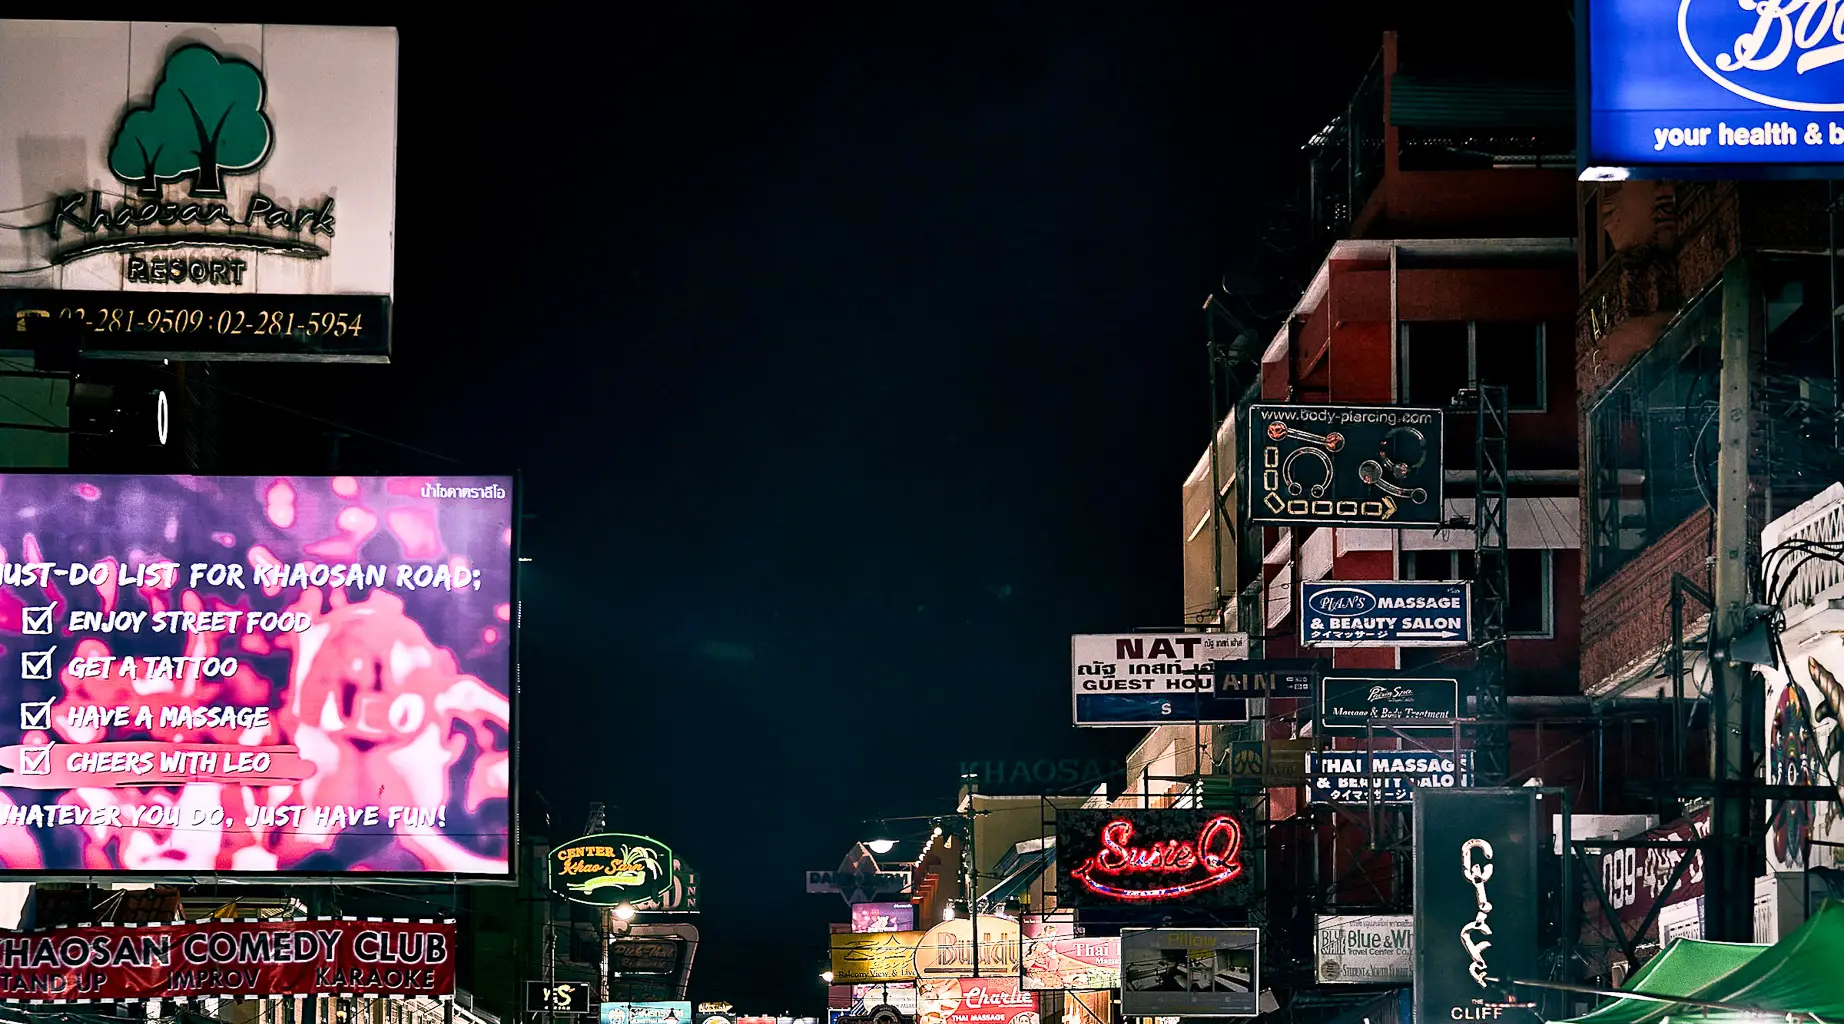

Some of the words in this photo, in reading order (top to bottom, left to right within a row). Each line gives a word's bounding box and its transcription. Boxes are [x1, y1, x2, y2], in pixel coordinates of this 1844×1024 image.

[1654, 125, 1711, 151] your
[1719, 121, 1797, 146] health
[1803, 122, 1823, 146] &
[51, 193, 232, 241] Khaosan
[244, 194, 337, 238] Park
[127, 258, 246, 285] RESORT
[1261, 409, 1432, 426] www.body-piercing.com
[0, 563, 110, 588] UST-DO
[118, 563, 180, 588] LIST
[190, 563, 245, 590] FOR
[253, 563, 387, 590] KHAOSAN
[1377, 597, 1461, 609] MASSAGE
[69, 611, 148, 633] ENJOY
[152, 611, 244, 634] STREET
[247, 612, 312, 634] FOOD
[1310, 618, 1325, 630] &
[1330, 618, 1397, 630] BEAUTY
[1402, 618, 1461, 630] SALON
[1311, 631, 1389, 639] タイマッサージ
[1116, 637, 1202, 660] NAT
[68, 656, 116, 680] GET
[119, 656, 138, 680] A
[144, 656, 238, 680] TATTOO
[1083, 679, 1155, 691] GUEST
[68, 705, 131, 730] HAVE
[135, 705, 153, 730] A
[160, 706, 270, 730] MASSAGE
[1381, 707, 1402, 719] Body
[1405, 708, 1449, 719] Treatment
[66, 752, 154, 775] CHEERS
[160, 752, 219, 775] WITH
[222, 752, 271, 774] LEO
[1317, 778, 1331, 789] &
[131, 805, 182, 828] YOU
[245, 805, 306, 828] JUST
[314, 805, 380, 829] HAVE
[387, 805, 447, 828] FUN!
[557, 846, 617, 861] CENTER
[1098, 820, 1196, 871] Susie
[1198, 815, 1241, 872] Q
[558, 858, 604, 875] Khao
[604, 858, 645, 875] Sarn
[183, 929, 343, 965] COMEDY
[353, 930, 448, 965] CLUB
[1073, 943, 1109, 957] Thai
[1348, 930, 1381, 948] Blue
[1383, 935, 1393, 947] &
[77, 972, 108, 993] UP
[167, 968, 262, 992] IMPROV
[315, 967, 436, 989] KARAOKE
[838, 970, 868, 979] Balcony
[963, 986, 1033, 1008] Charlie
[1451, 1007, 1503, 1020] CLIFF
